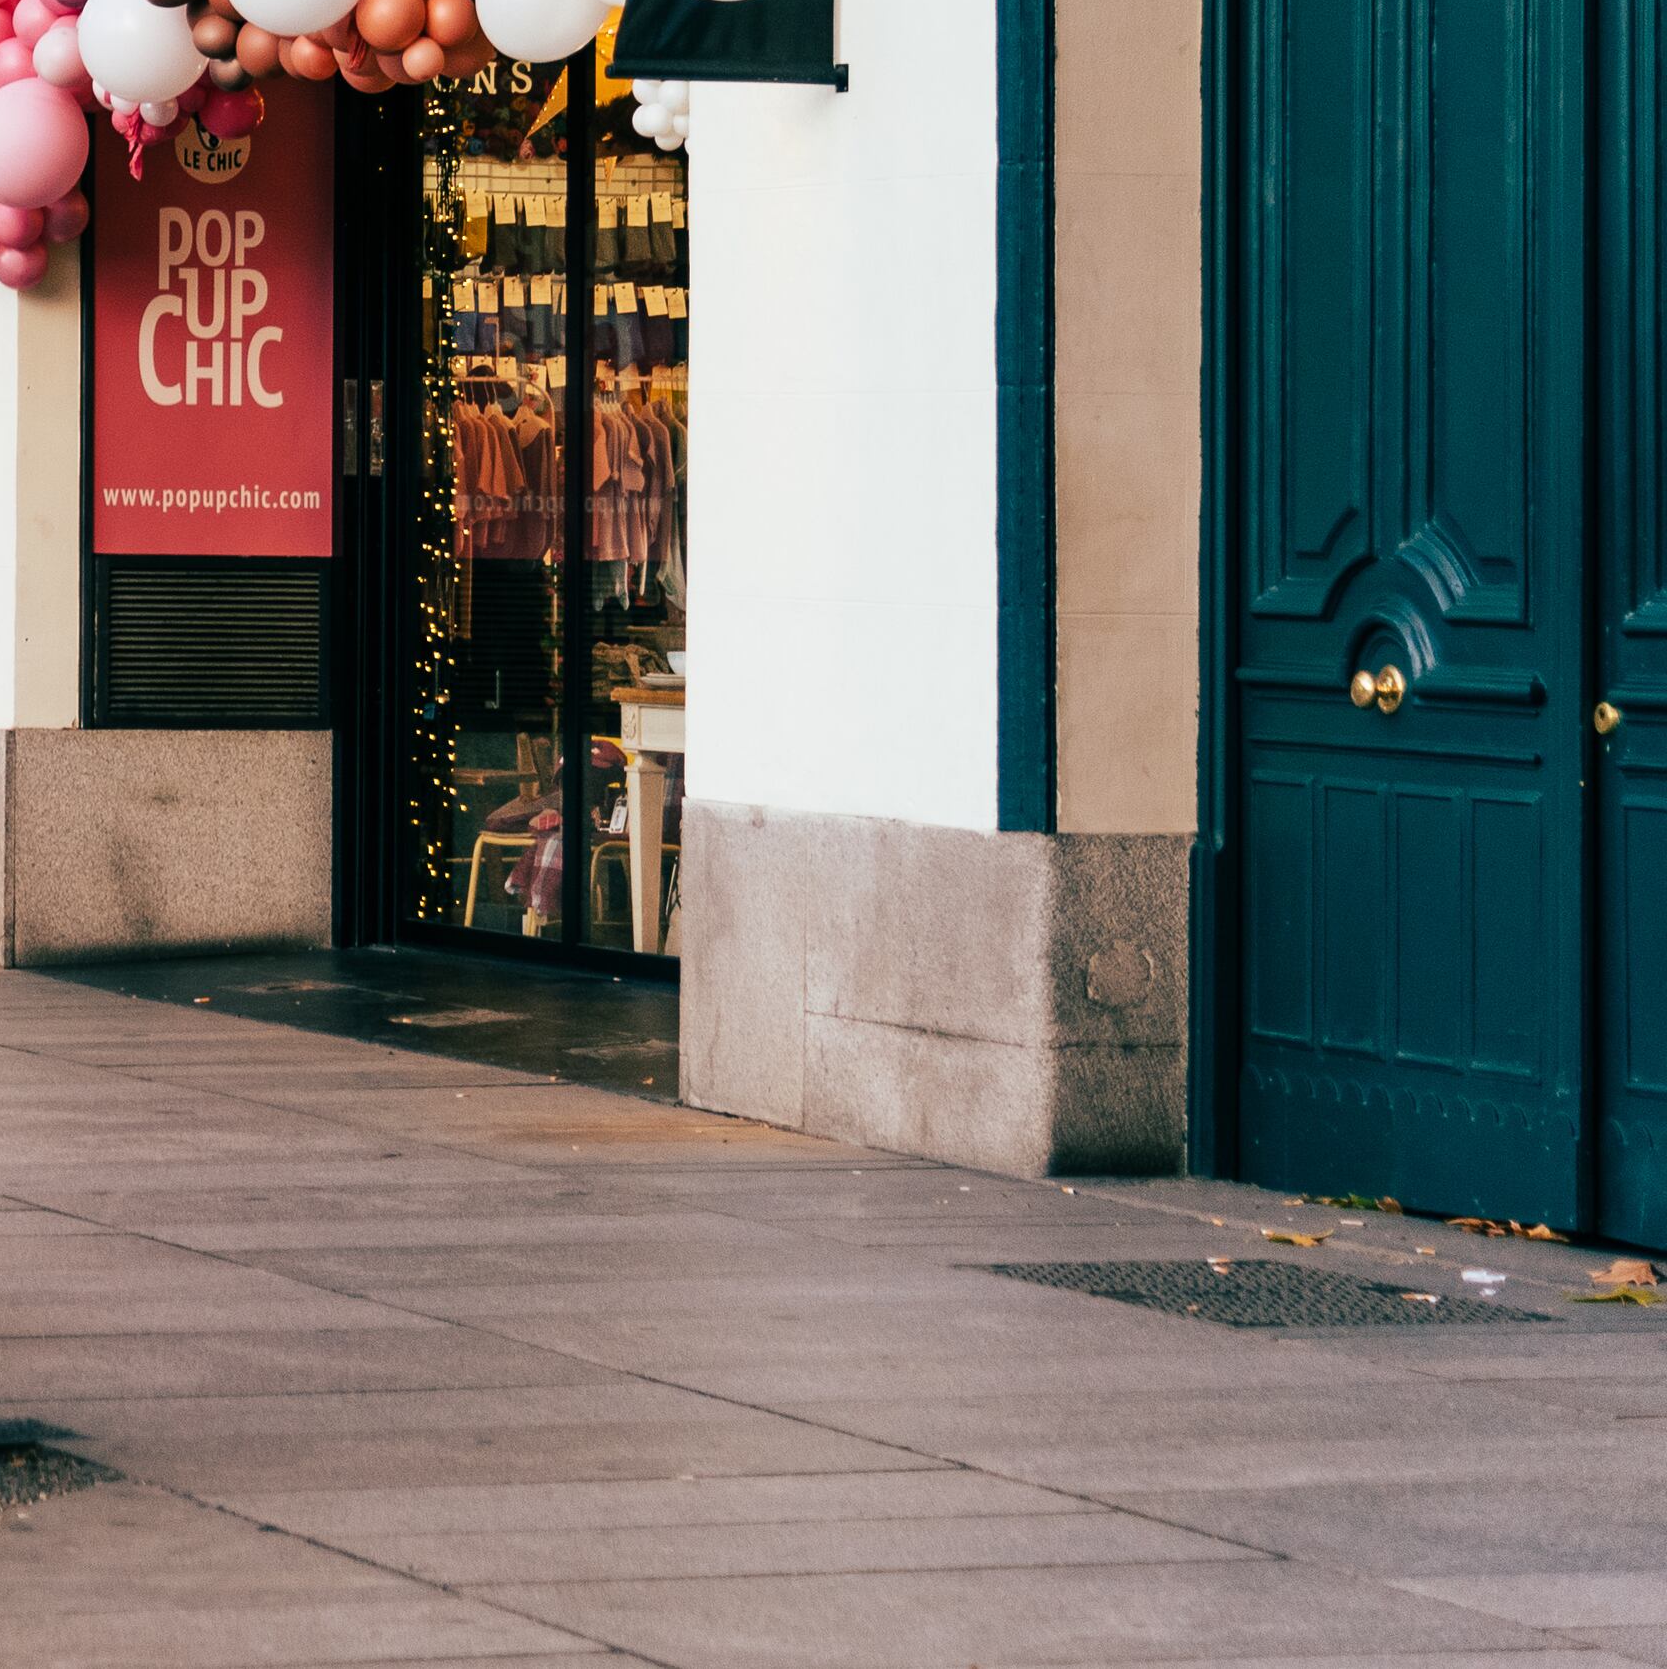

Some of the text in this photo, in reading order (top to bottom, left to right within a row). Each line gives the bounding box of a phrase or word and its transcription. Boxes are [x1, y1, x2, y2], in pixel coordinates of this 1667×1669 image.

[183, 148, 242, 172] LE CHIC
[158, 207, 265, 291] POP
[178, 267, 269, 340] UP
[103, 484, 320, 514] www.popupchic.com
